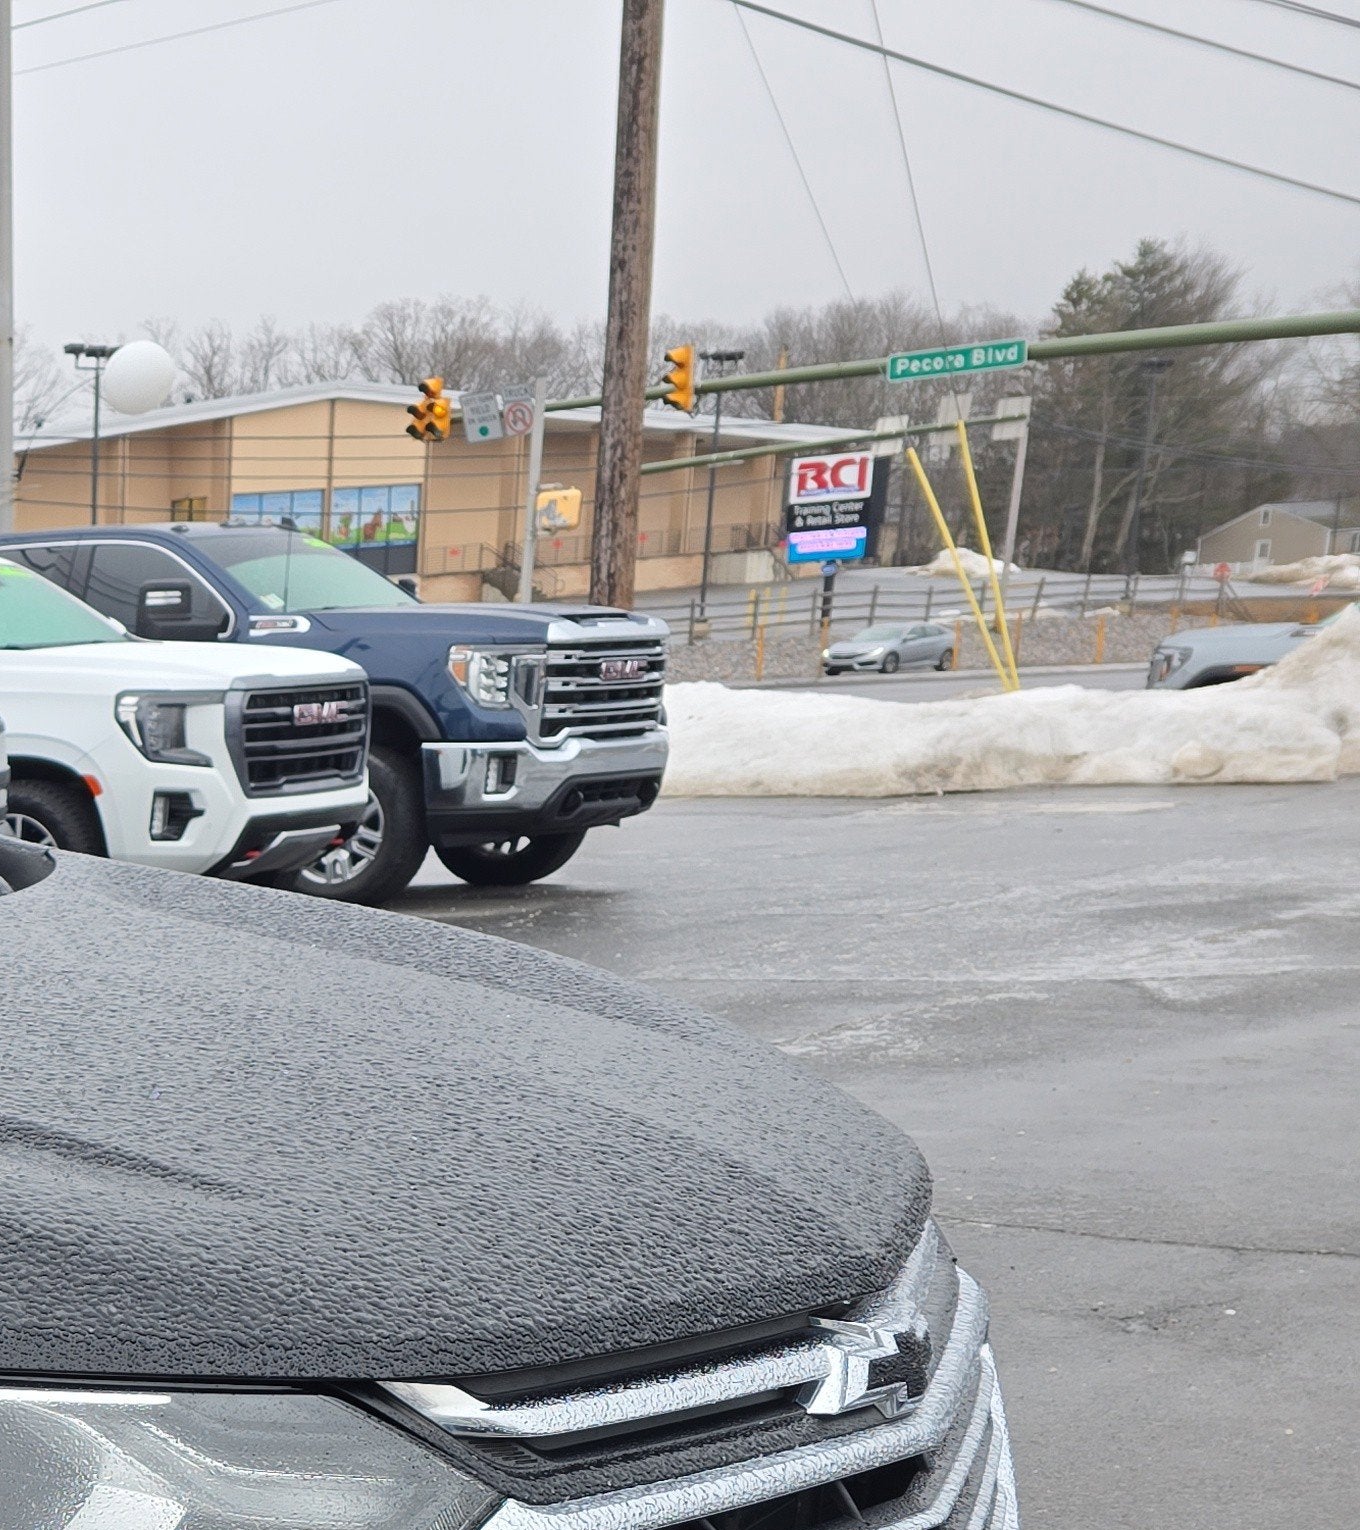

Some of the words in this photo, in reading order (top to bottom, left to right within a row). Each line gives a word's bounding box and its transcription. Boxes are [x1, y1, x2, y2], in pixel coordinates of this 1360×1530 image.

[896, 353, 965, 376] Pecora
[971, 344, 1018, 366] Blvd
[797, 456, 870, 497] RCI
